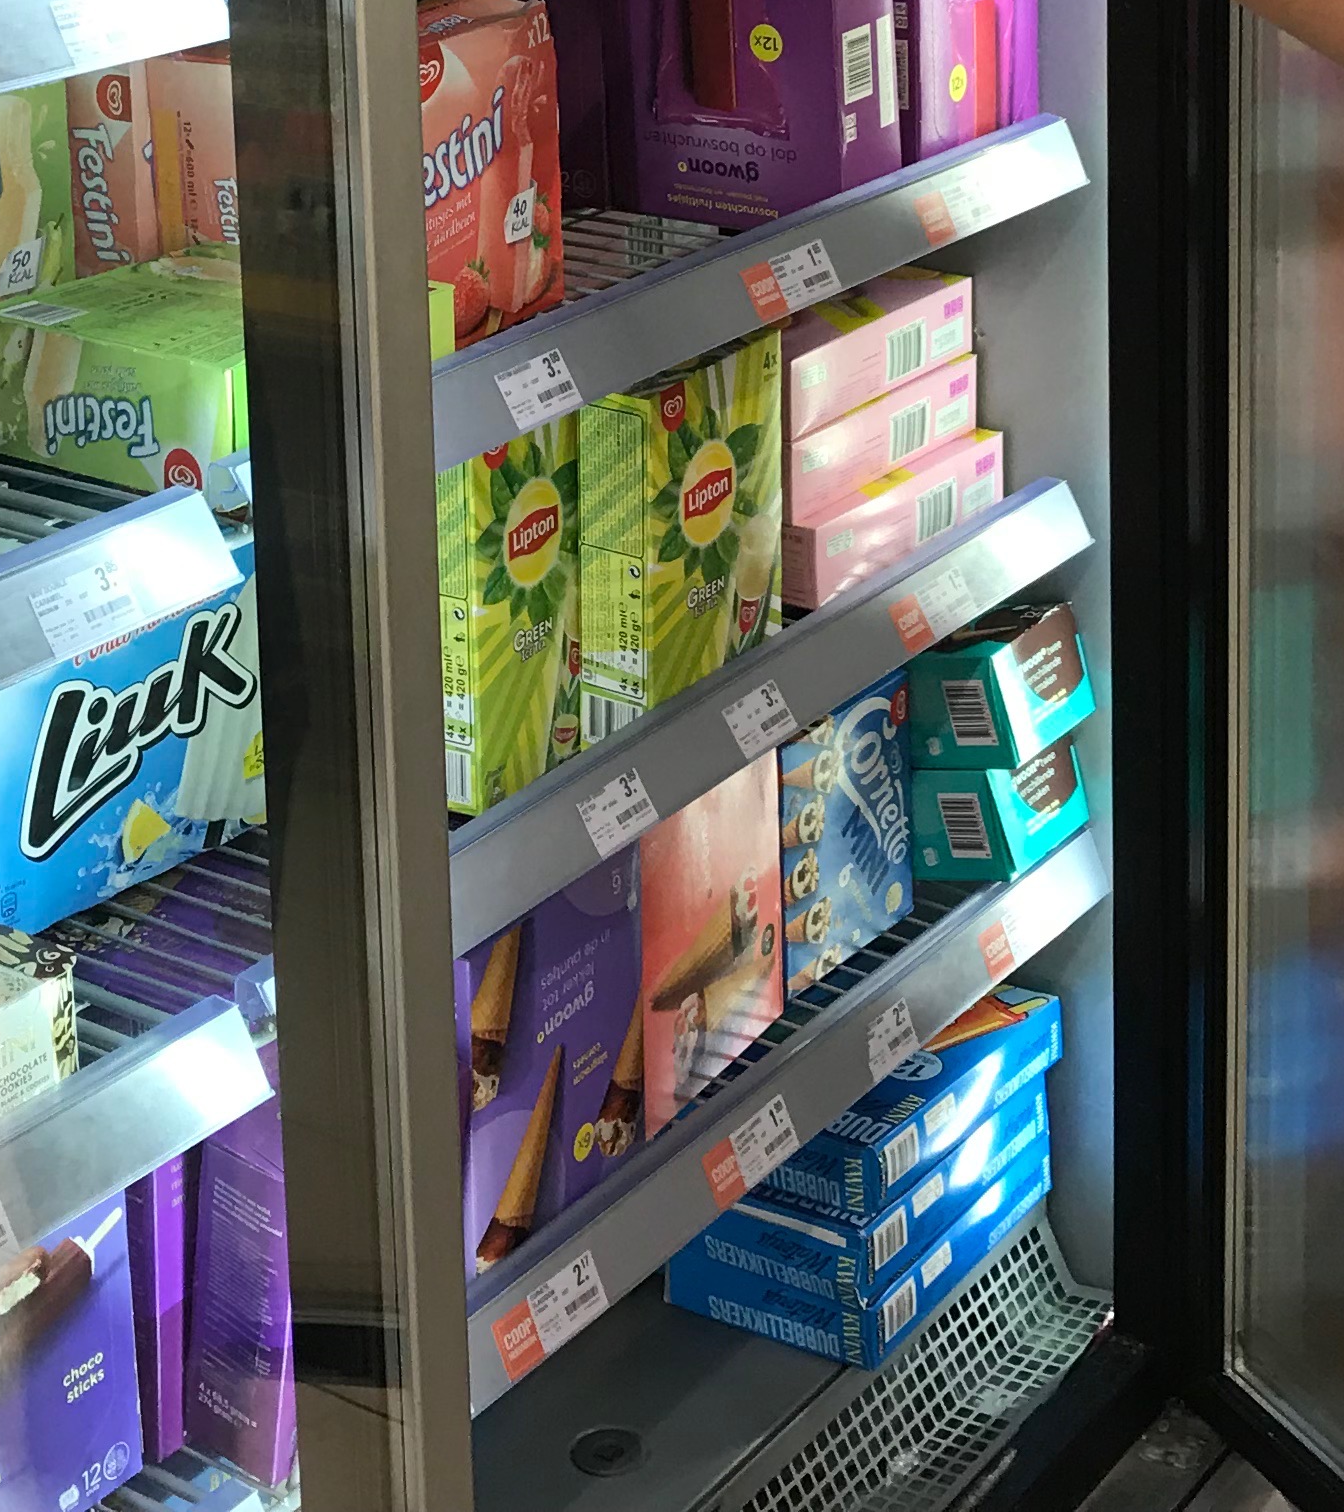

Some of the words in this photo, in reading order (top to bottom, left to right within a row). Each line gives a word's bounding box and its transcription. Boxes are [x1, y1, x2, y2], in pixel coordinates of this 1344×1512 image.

[527, 12, 551, 48] x12
[754, 35, 779, 52] 12x
[423, 86, 505, 209] estini
[745, 139, 766, 160] op
[688, 157, 760, 184] gwoon
[72, 122, 132, 267] Festini
[513, 198, 528, 217] 40
[716, 199, 779, 218] bosvruchten
[511, 216, 531, 231] KCAL
[10, 249, 32, 268] 50
[7, 270, 34, 287] KCAL
[751, 276, 775, 296] COOP
[763, 352, 778, 371] 4x
[43, 392, 161, 460] Festini
[687, 475, 729, 511] Lipton
[513, 512, 556, 553] Lipton
[687, 575, 726, 609] GREEN
[513, 616, 554, 653] GREEN
[445, 673, 454, 699] 420
[457, 680, 466, 703] 420
[834, 695, 912, 864] Cornetto
[564, 961, 596, 994] lekker
[543, 981, 595, 1035] gwoon
[882, 1094, 926, 1125] KWINI
[711, 1155, 735, 1184] COOP
[845, 1157, 863, 1212] KWINI
[705, 1235, 835, 1301] DUBBELLIKKERS
[837, 1255, 856, 1308] KWINI
[502, 1319, 533, 1349] COOP
[572, 1253, 590, 1286] 2.17
[707, 1295, 839, 1359] DUBBELLIKKERS
[842, 1311, 861, 1365] KWINI
[62, 1351, 104, 1387] choco
[66, 1368, 106, 1404] sticks
[81, 1463, 102, 1491] 12
